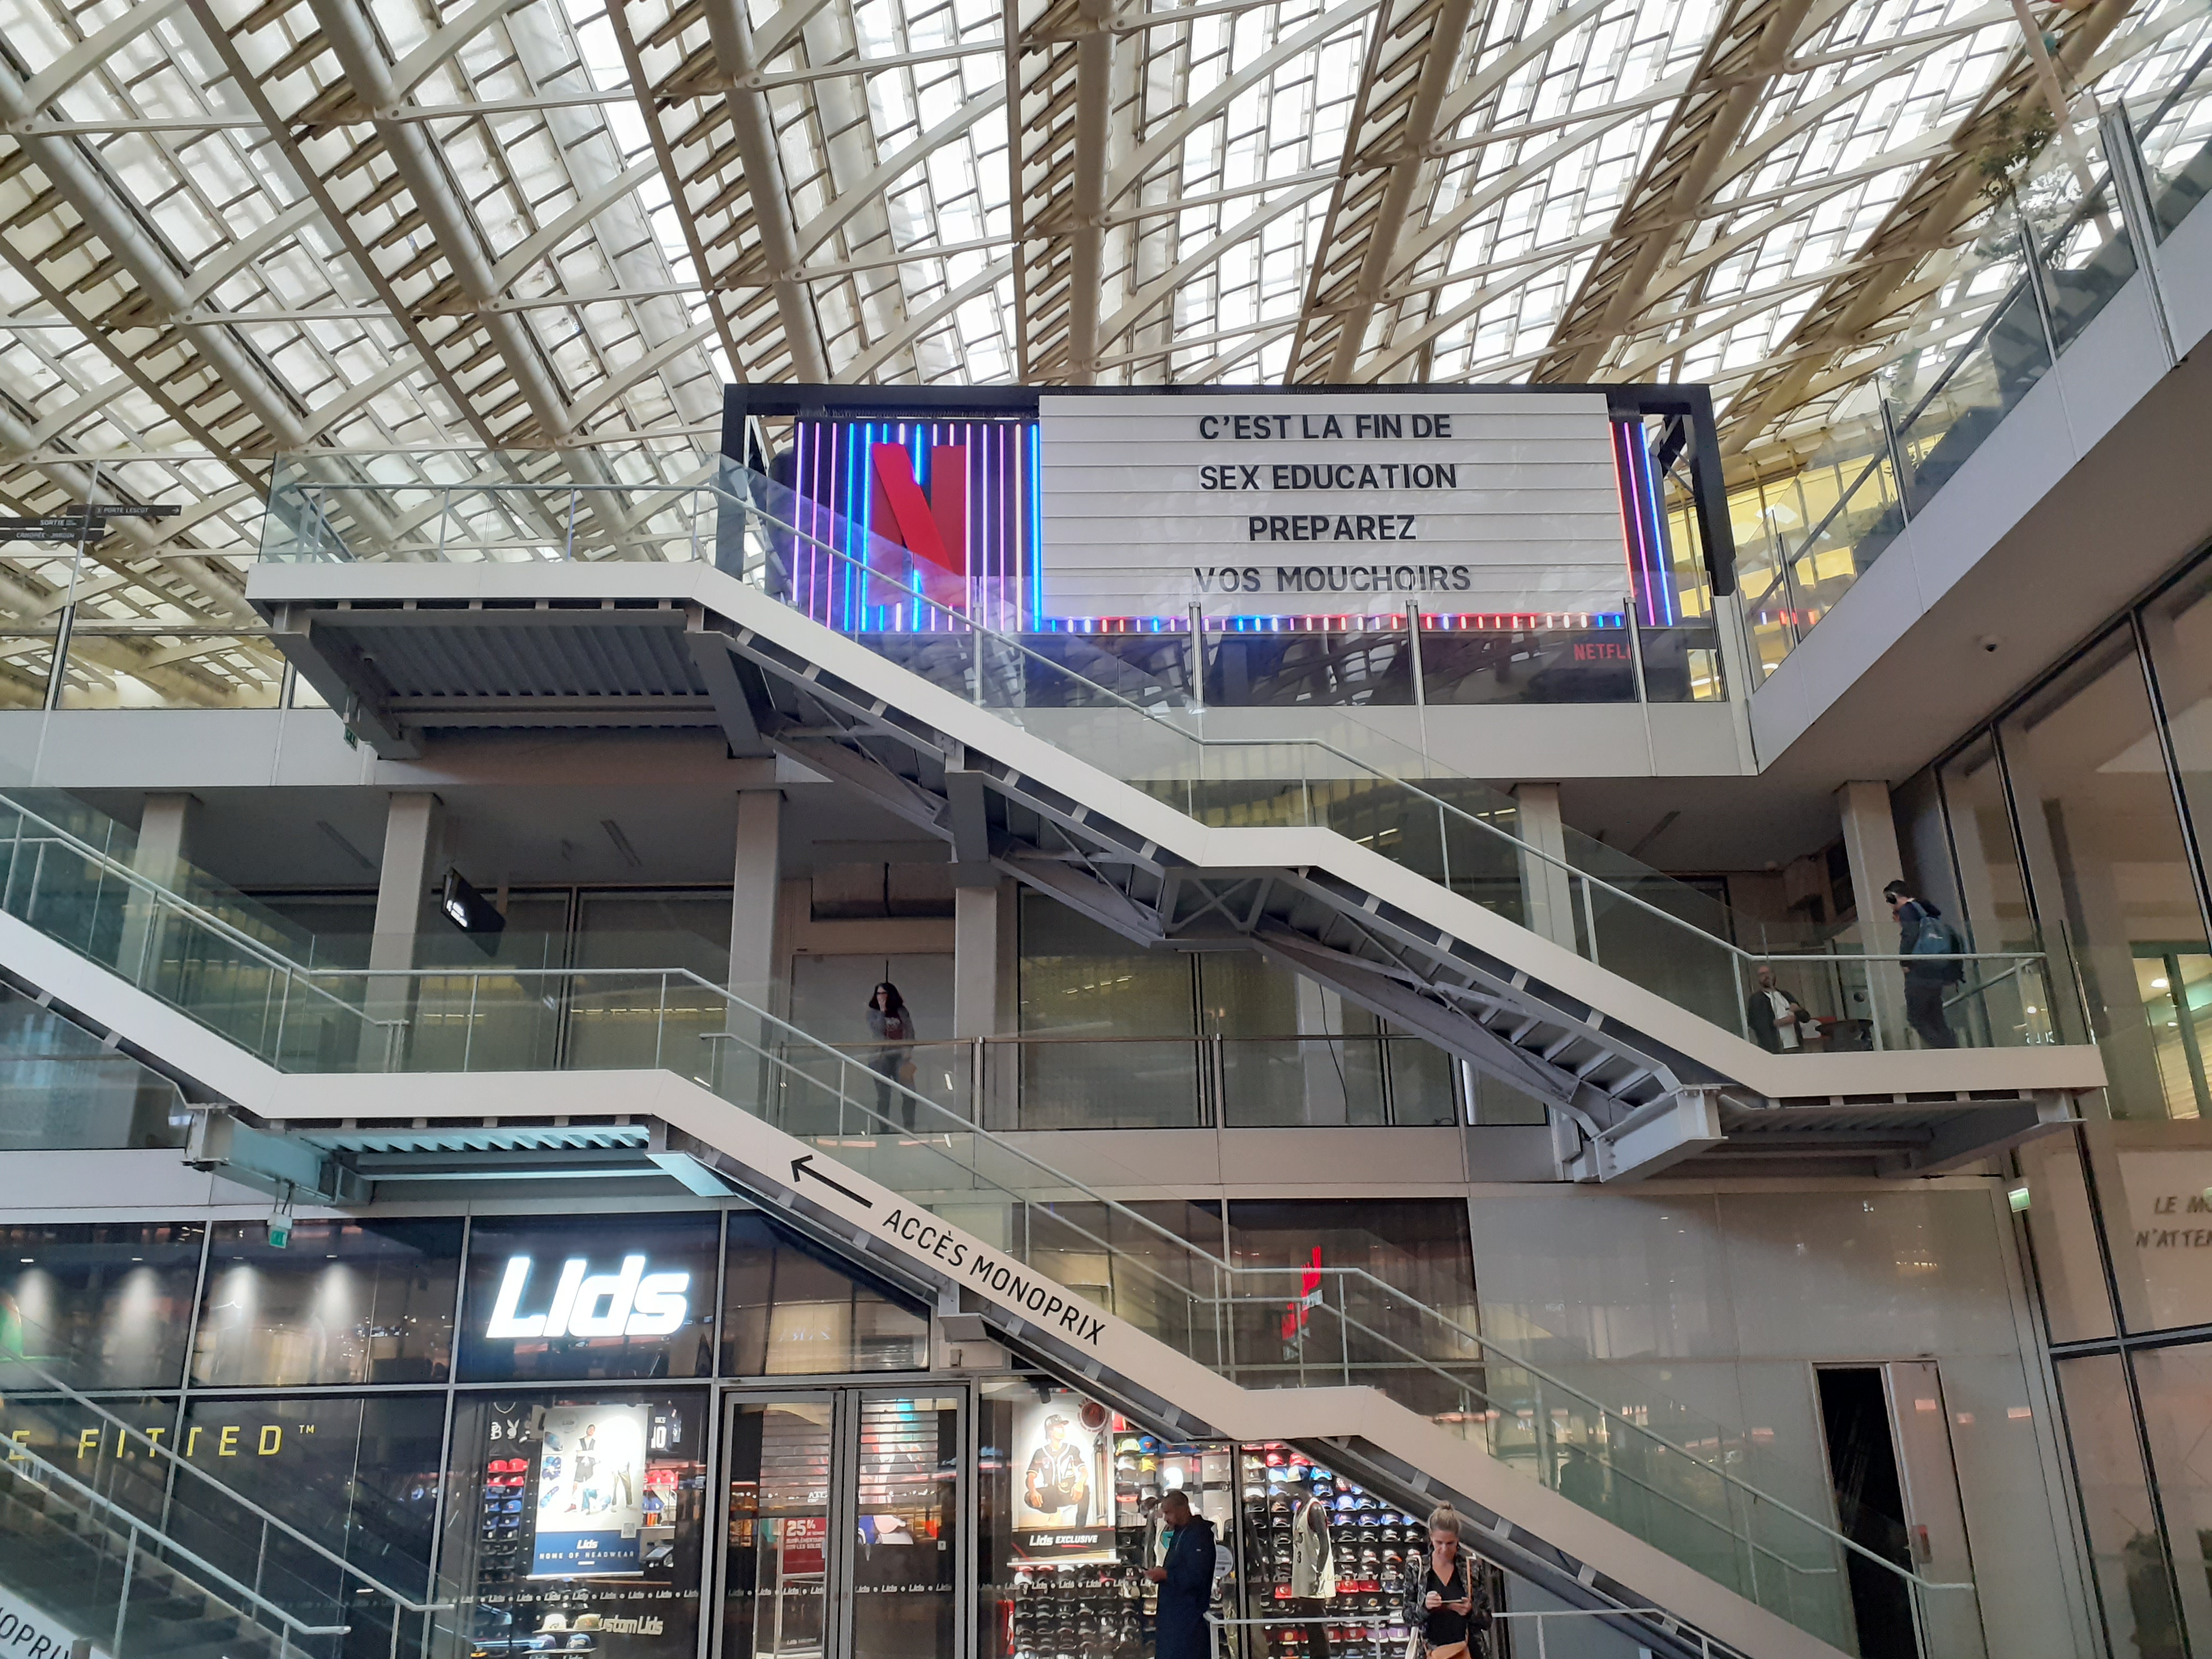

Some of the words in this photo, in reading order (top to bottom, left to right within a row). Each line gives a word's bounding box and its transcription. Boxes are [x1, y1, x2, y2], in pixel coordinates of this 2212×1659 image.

[1199, 414, 1291, 440] C'EST
[1302, 414, 1343, 439] LA
[1356, 414, 1402, 439] FIN
[1411, 414, 1453, 438] DE
[1200, 465, 1260, 490] SEX
[1272, 464, 1456, 490] EDUCATION
[1249, 514, 1416, 542] PREPAREZ
[1194, 567, 1260, 593] VOS
[1276, 566, 1471, 592] MOUCHOIRS
[2154, 1195, 2178, 1215] LE
[883, 1209, 968, 1267] ACCÈS
[969, 1254, 1107, 1347] MONOPRIX
[577, 1540, 599, 1549] Lids
[1029, 1535, 1053, 1546] Lids
[1055, 1535, 1098, 1544] EXCLUSIVE
[637, 1615, 664, 1635] Lids
